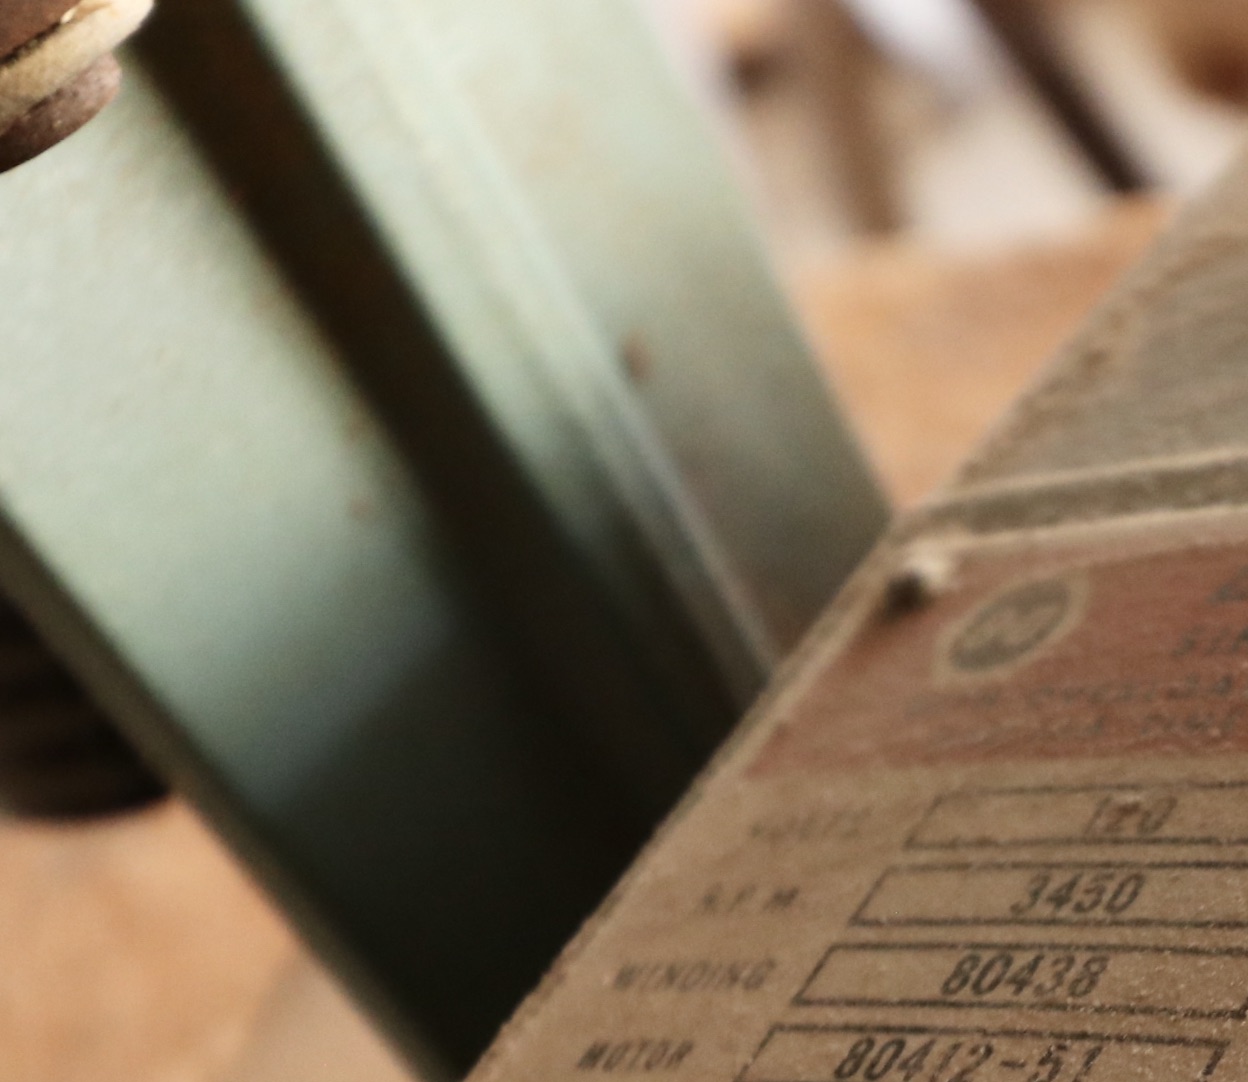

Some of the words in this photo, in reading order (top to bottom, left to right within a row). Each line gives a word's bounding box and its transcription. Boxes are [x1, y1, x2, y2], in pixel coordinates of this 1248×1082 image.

[1083, 795, 1178, 837] 120
[1008, 873, 1147, 915] 3450
[611, 957, 778, 992] WINDING
[941, 952, 1109, 1000] 80438
[576, 1041, 697, 1074] MOTOR
